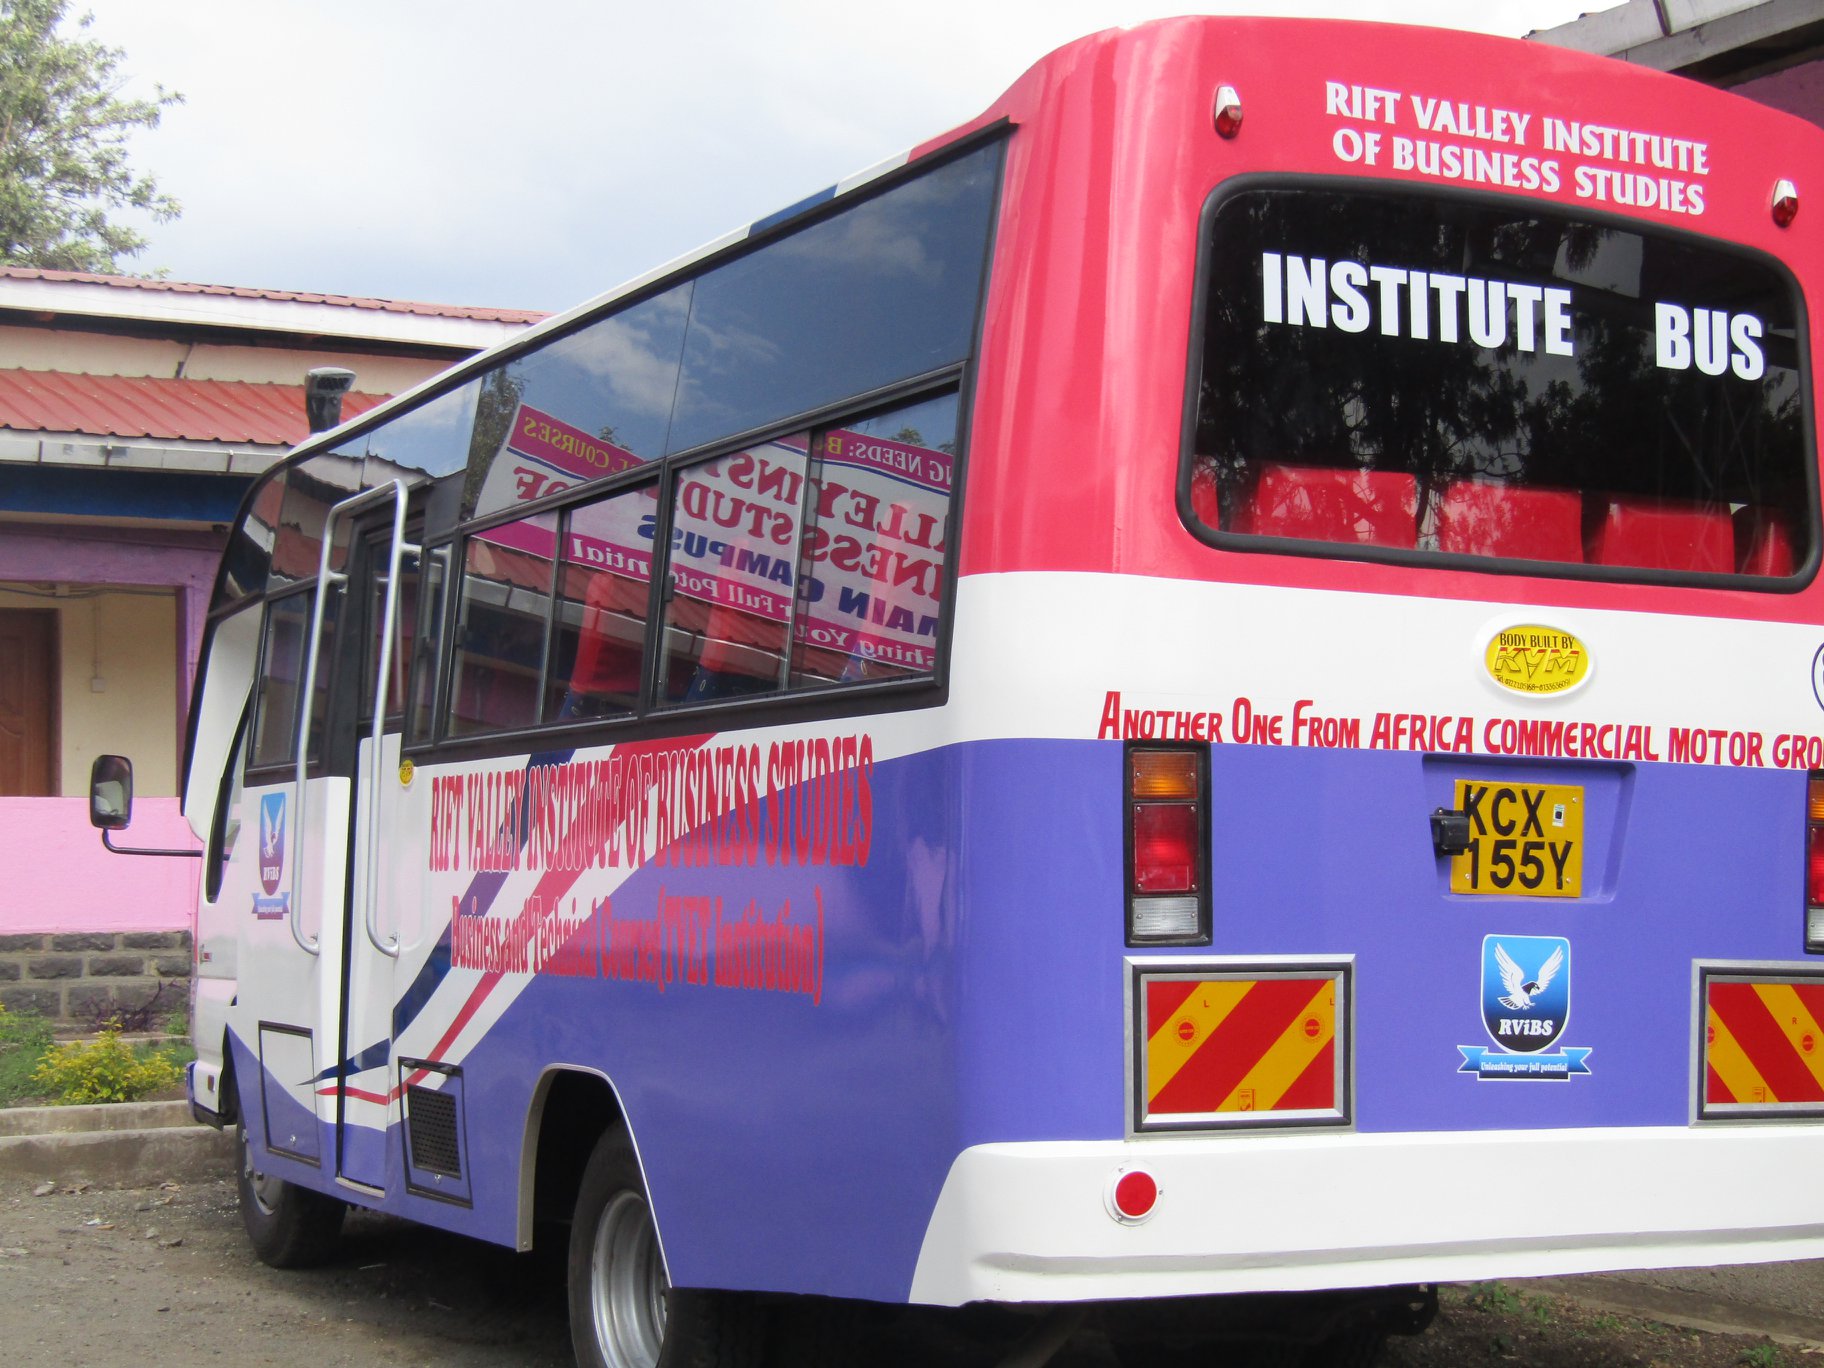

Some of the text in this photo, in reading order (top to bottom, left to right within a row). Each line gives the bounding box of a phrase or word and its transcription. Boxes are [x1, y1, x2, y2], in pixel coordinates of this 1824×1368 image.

[1325, 81, 1709, 176] RIFT VALLEY INSTITUTE
[1333, 128, 1705, 216] OF BUSINESS STUDIES
[1262, 252, 1765, 382] INSTITUTE BUS
[1500, 633, 1574, 649] BODY BUILT BY
[1370, 712, 1474, 753] AFRICA
[1483, 718, 1659, 762] COMMERCIAL
[1668, 727, 1764, 768] MOTOR
[1772, 734, 1824, 770] GRO
[429, 733, 874, 873] RIFT VALLEY INSTITUTE OF BUSINESS STUDIES
[1463, 784, 1545, 838] KCX
[1466, 838, 1573, 890] 155Y
[451, 895, 500, 973] Business
[500, 897, 529, 974] and
[530, 895, 597, 979] Technical
[1498, 1018, 1554, 1036] RViBS
[1481, 1061, 1568, 1073] Unleashing your full potential
